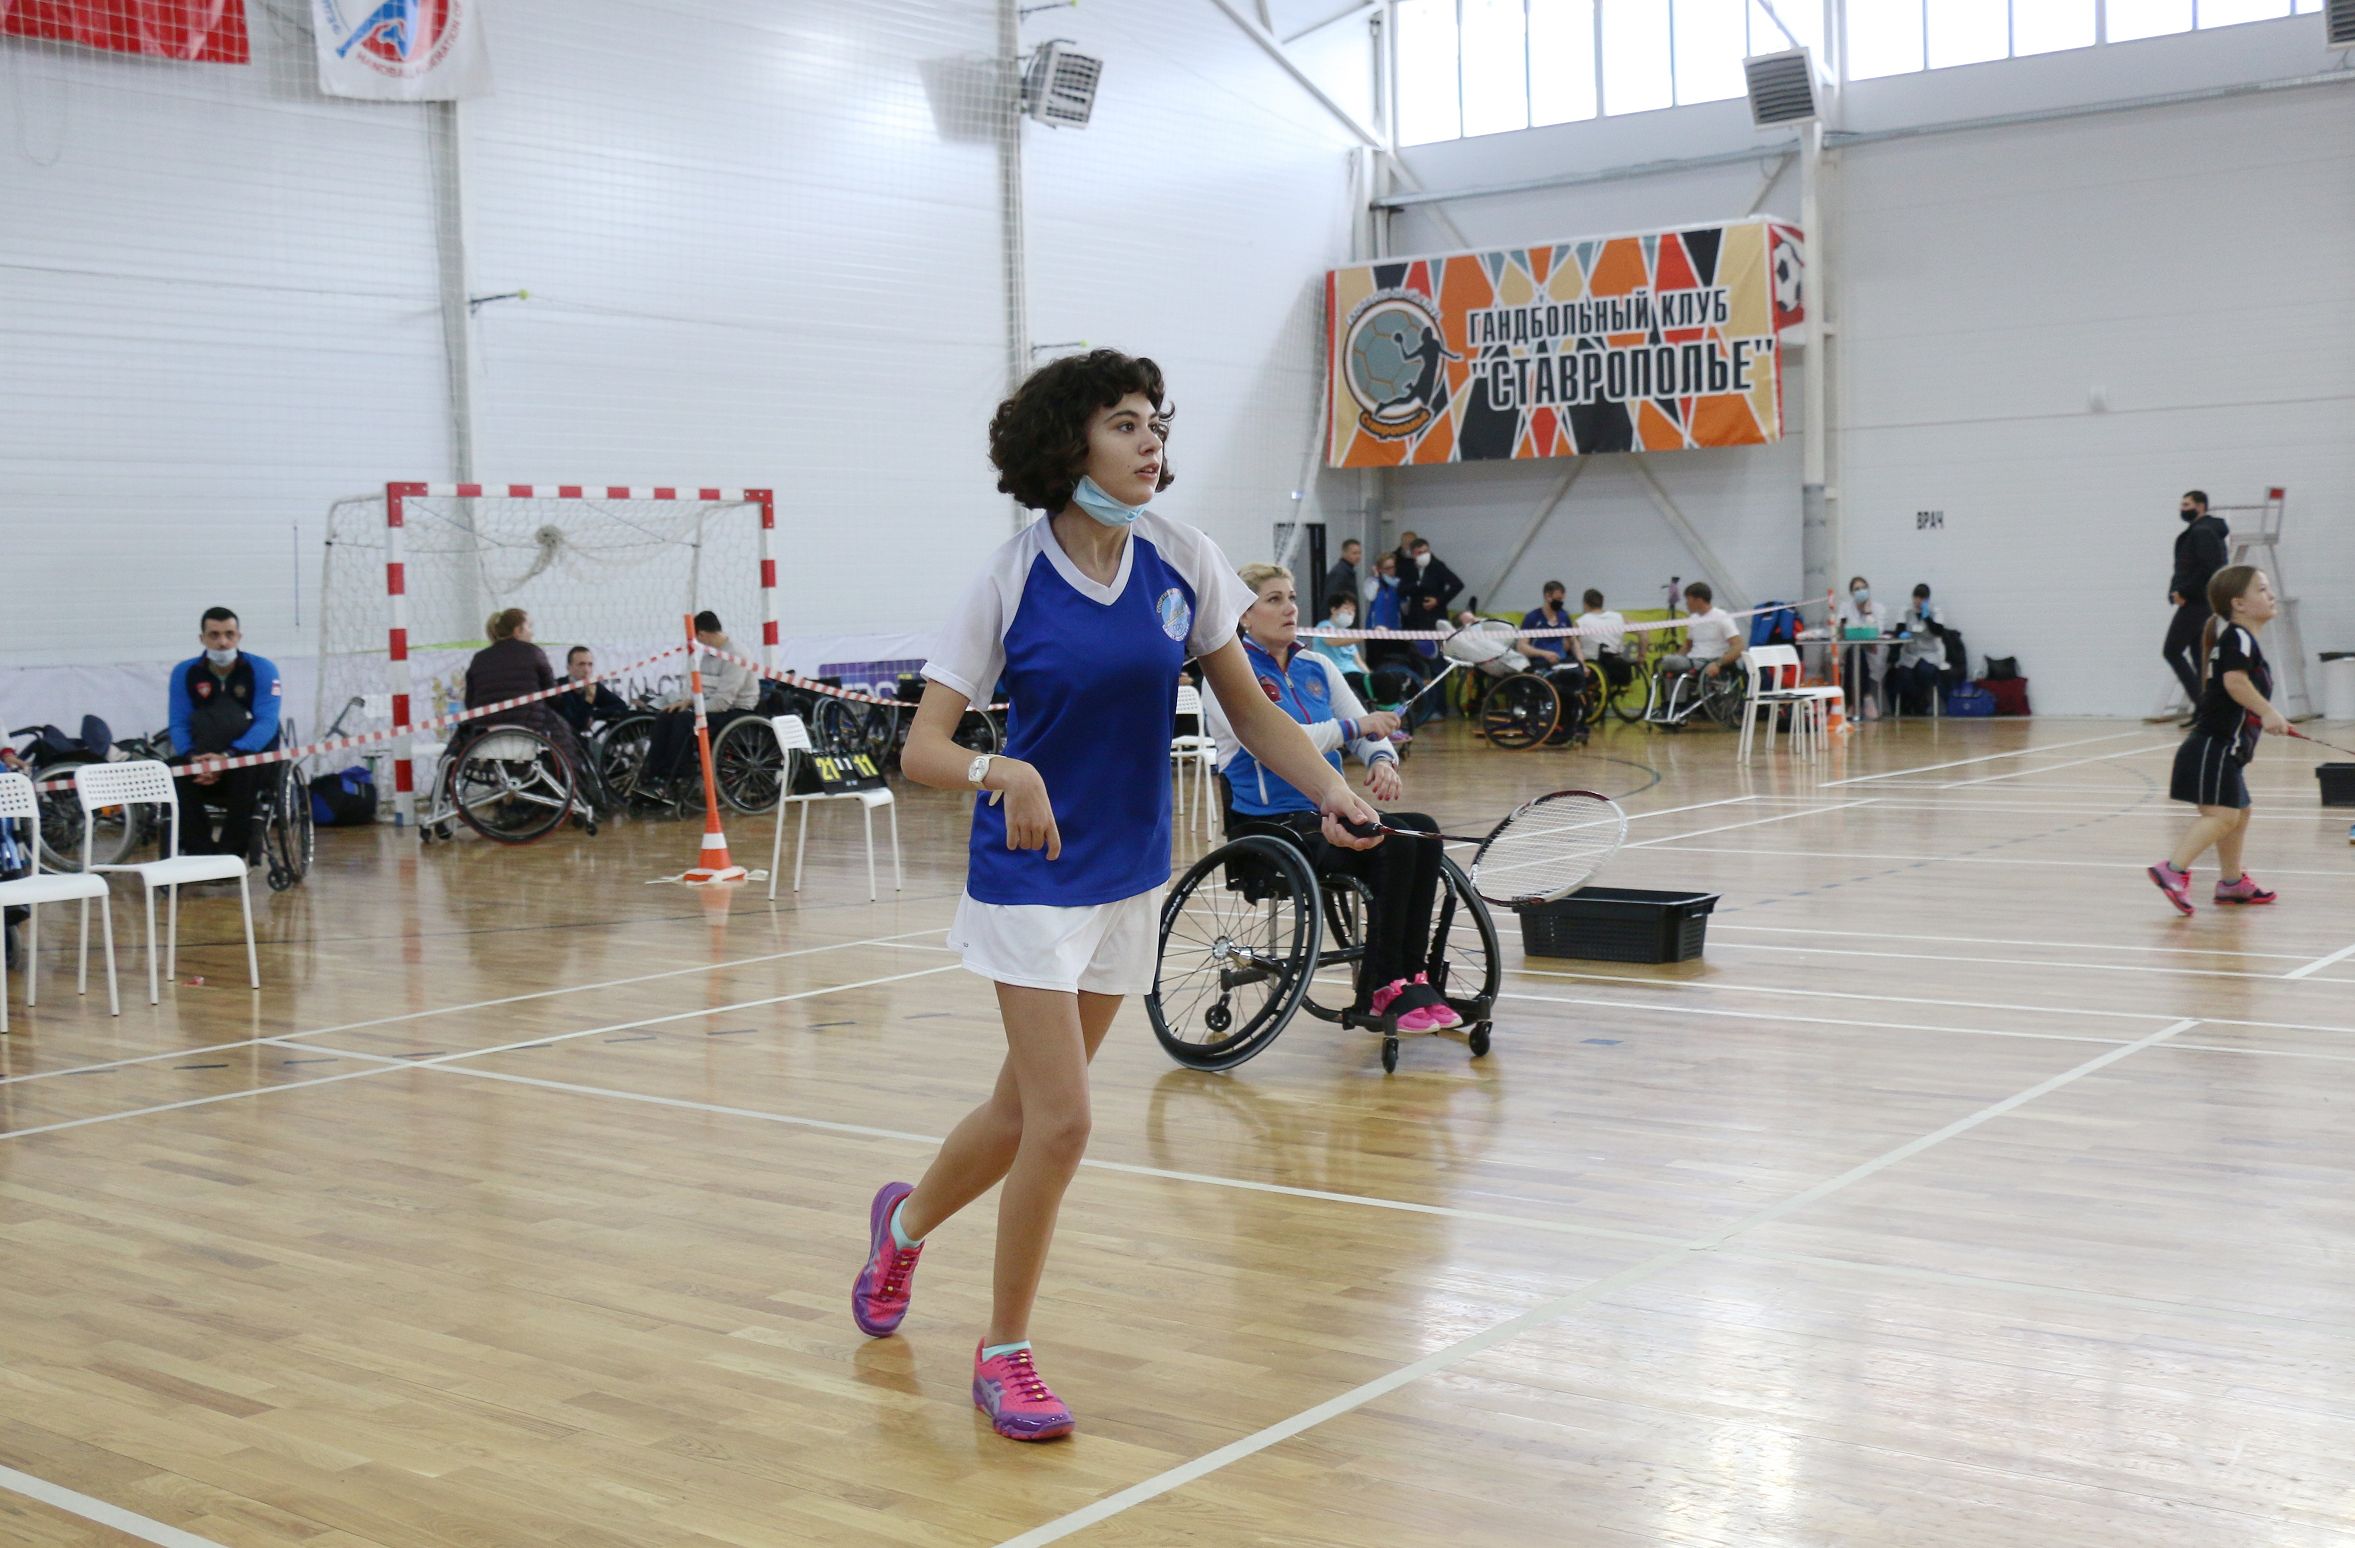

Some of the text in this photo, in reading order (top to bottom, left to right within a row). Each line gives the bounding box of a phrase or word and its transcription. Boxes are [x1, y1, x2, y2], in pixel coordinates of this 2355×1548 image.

[1469, 290, 1649, 345] ГАНДБОЛЬНЫЙ
[1662, 289, 1727, 331] КЛУБ
[1472, 338, 1774, 409] "СТАВРОПОЛЬЕ"
[1917, 510, 1945, 530] ВРАЧ
[815, 756, 841, 781] 21
[853, 754, 879, 777] 11
